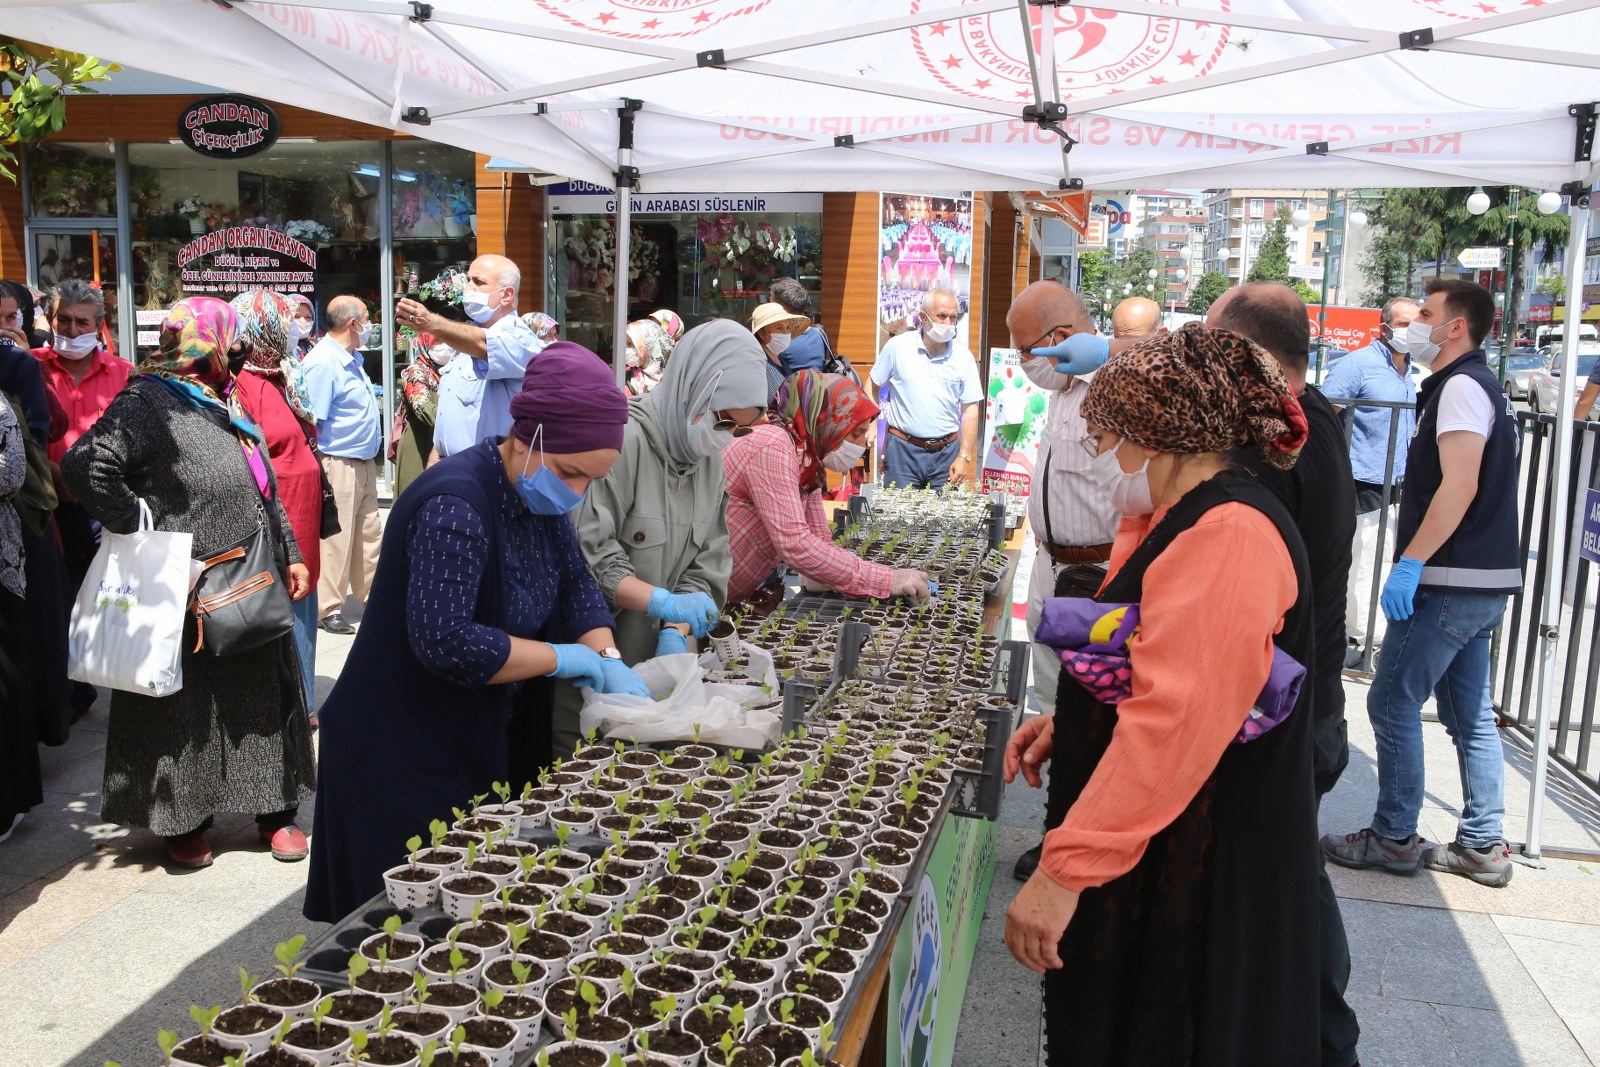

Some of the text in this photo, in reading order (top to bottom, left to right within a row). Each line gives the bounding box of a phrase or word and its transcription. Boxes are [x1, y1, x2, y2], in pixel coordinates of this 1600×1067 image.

[185, 103, 268, 130] CANDAN
[192, 128, 264, 152] ÇİÇEKÇİLİK
[606, 196, 766, 212] GİN ARABASI SÜSLENİR
[178, 224, 317, 270] CANDAN ORGANİZASYON
[215, 253, 244, 269] DÜĞÜN,
[245, 253, 269, 270] NİŞAN
[182, 268, 314, 282] ÖZEL GÜNLERİNİZDE YANINIZDAYIZ
[1333, 328, 1351, 337] Güzel
[1352, 329, 1365, 339] Çay
[1348, 337, 1360, 347] Çay
